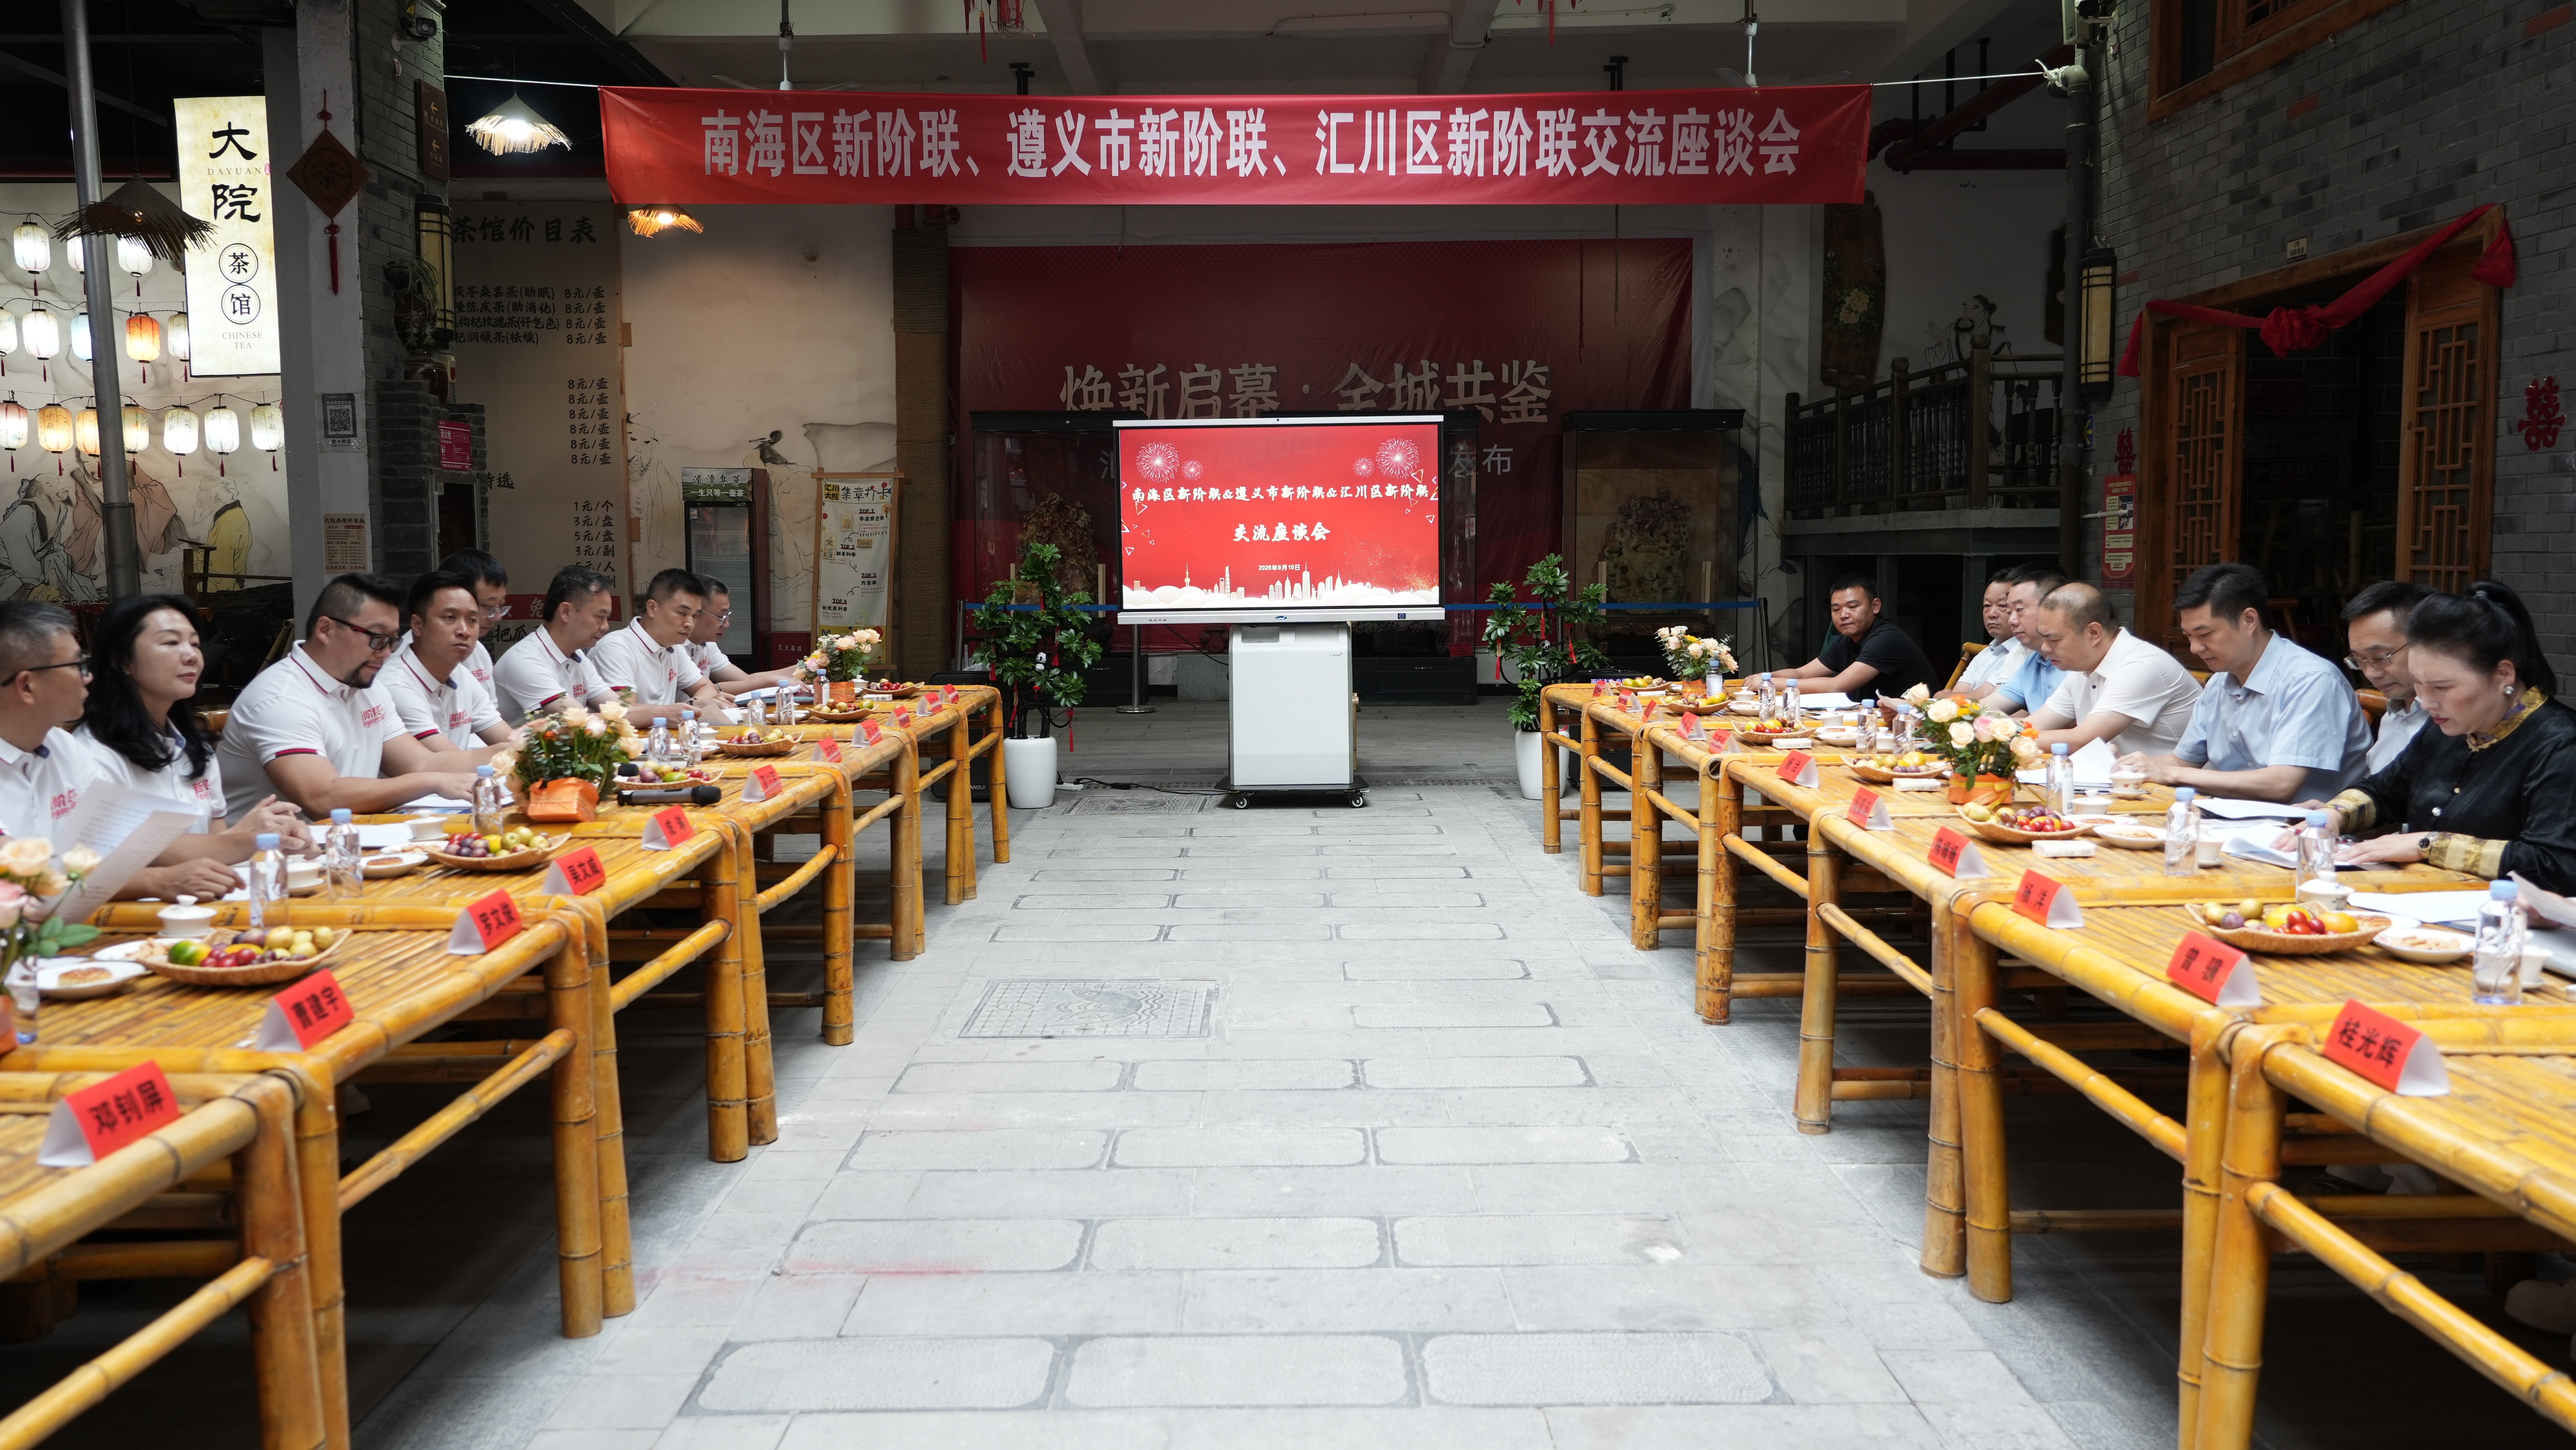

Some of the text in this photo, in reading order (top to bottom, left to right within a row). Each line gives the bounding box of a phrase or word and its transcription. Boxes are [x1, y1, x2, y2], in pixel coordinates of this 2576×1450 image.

[701, 108, 1800, 177] 南海区新阶联、遵义市新阶联、汇川区新阶联交流座谈会
[452, 215, 597, 244] 茶馆价目表
[228, 253, 251, 315] 茶馆
[565, 286, 605, 299] 8元/壶
[566, 301, 606, 314] 8元/壶
[456, 316, 607, 331] 枸杞玫瑰茶(好气色) 8元/壶
[566, 332, 607, 344] 8元/壶
[568, 377, 608, 390] 8元/壶
[568, 392, 609, 405] 8元/壶
[1060, 362, 1551, 424] 焕新启幕·全城共鉴
[569, 407, 609, 420] 8元/壶
[570, 422, 610, 435] 8元/壶
[570, 437, 611, 450] 8元/壶
[571, 452, 611, 465] 8元/壶
[693, 474, 741, 488] 湄潭翠芽
[824, 483, 840, 492] 汇川
[690, 489, 744, 497] 一生只等一壶茶
[824, 492, 840, 500] 大院
[841, 486, 890, 501] 集章打卡
[1132, 483, 1429, 502] 南海区新阶联&遵义市新阶联&汇川区新阶联
[574, 500, 613, 512] 1元/个
[574, 515, 614, 527] 3元/盘
[575, 529, 615, 542] 5元/盘
[1232, 521, 1331, 542] 交流座谈会
[575, 544, 614, 557] 3元/副
[494, 624, 541, 642] 把瓜
[2337, 1016, 2403, 1069] 桂光辉
